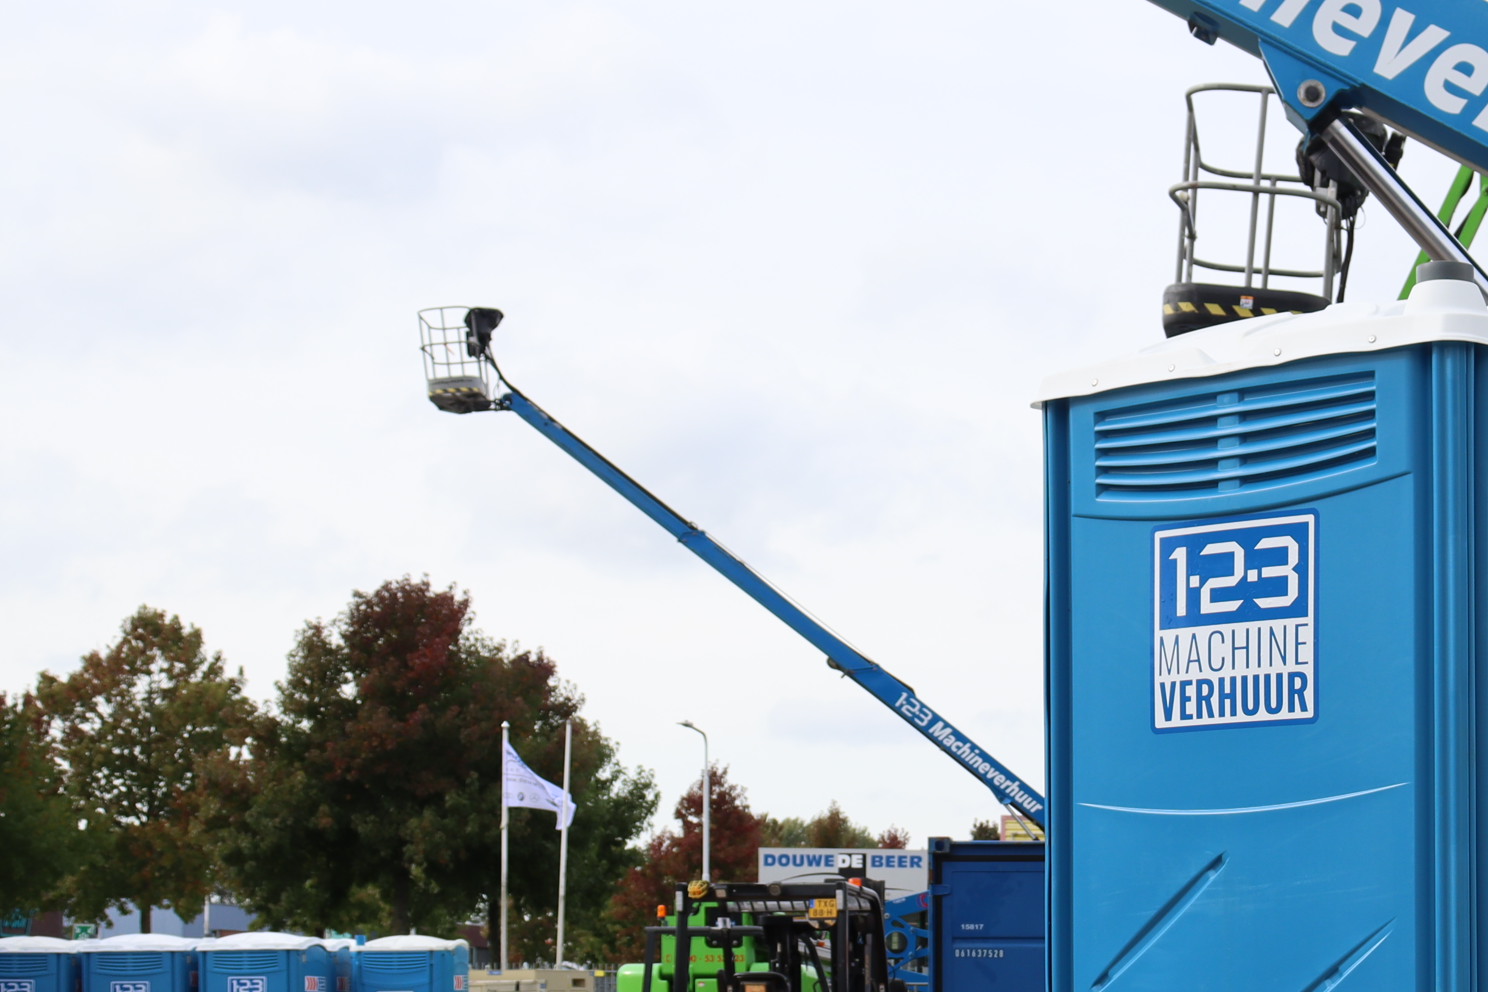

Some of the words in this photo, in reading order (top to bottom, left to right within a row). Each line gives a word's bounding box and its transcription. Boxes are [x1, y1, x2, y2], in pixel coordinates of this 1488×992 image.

[1158, 623, 1309, 677] MACHINE
[1159, 672, 1309, 722] VERHUUR
[928, 721, 1044, 814] Machineverhuur
[763, 854, 835, 867] DOUWE
[837, 854, 864, 868] DE
[870, 855, 923, 869] BEER
